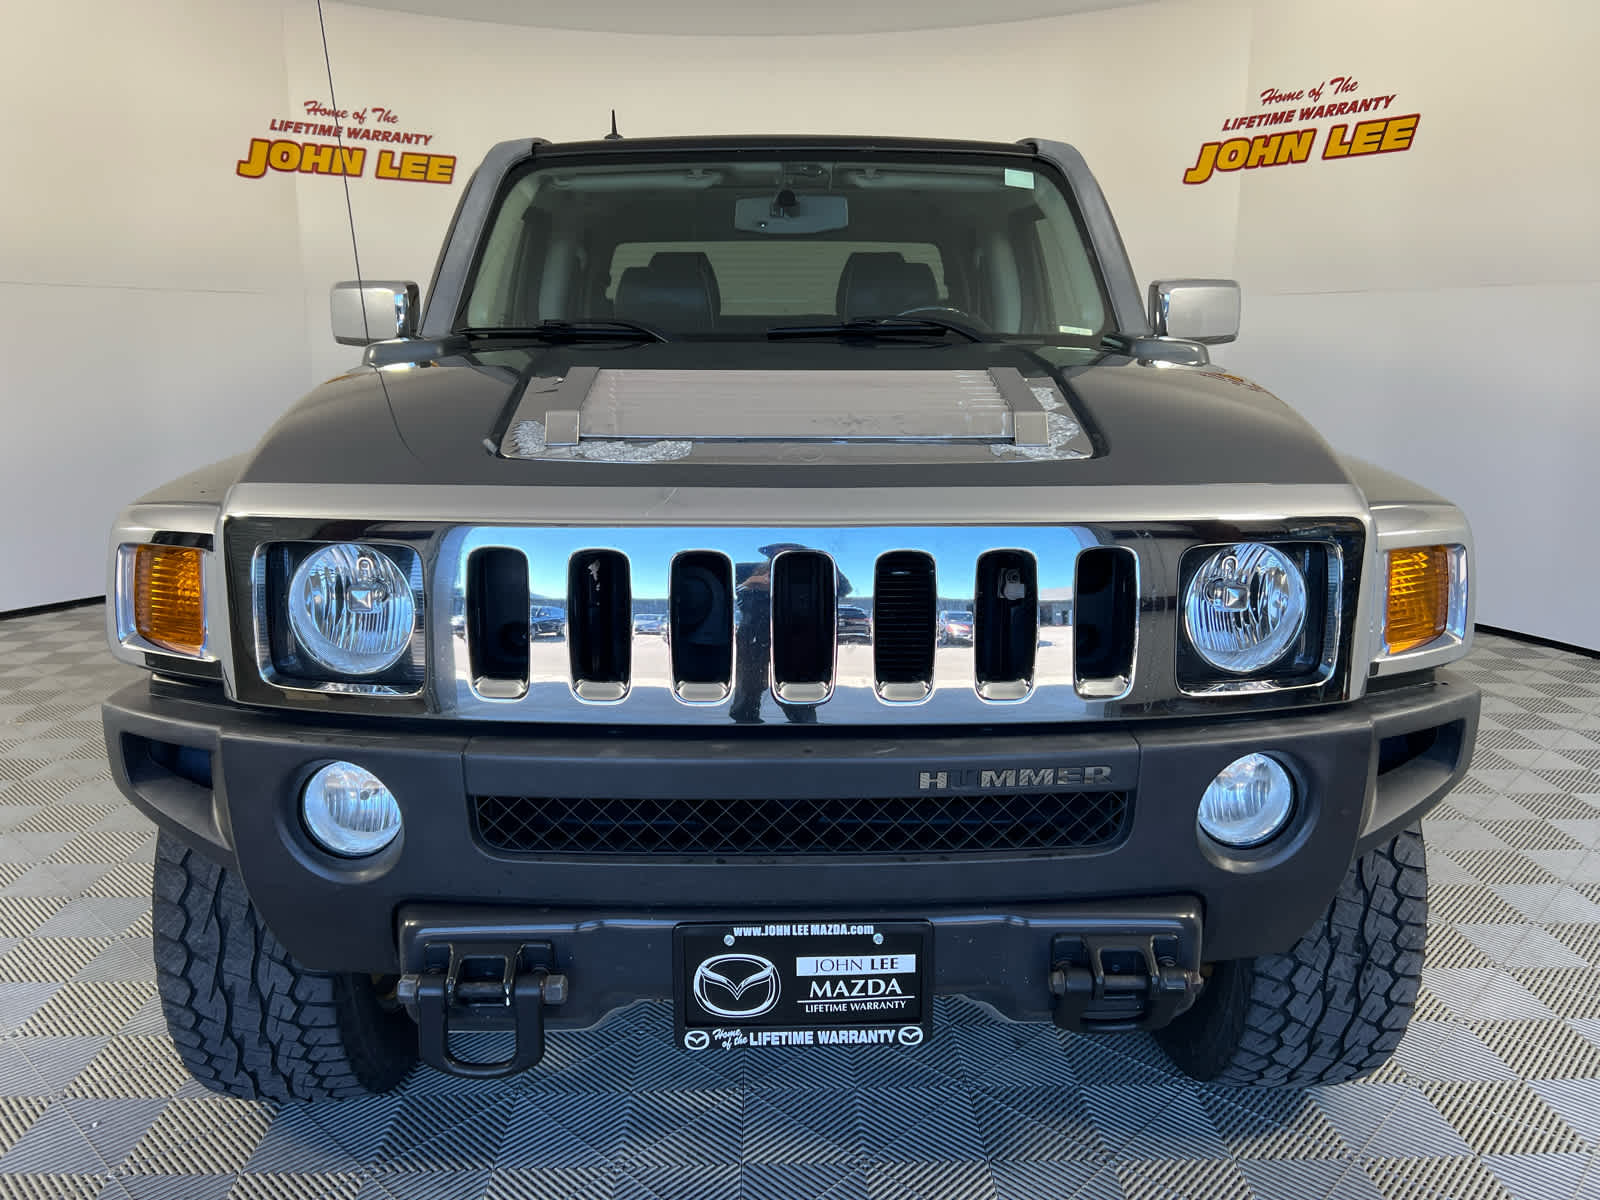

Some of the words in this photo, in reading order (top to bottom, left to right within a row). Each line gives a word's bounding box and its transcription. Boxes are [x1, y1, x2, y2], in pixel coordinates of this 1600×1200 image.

[1260, 88, 1303, 106] Home
[1308, 82, 1325, 102] of
[1329, 76, 1359, 96] The
[304, 100, 348, 119] Home
[352, 108, 367, 124] of
[371, 107, 399, 124] The
[1222, 109, 1296, 132] LIFETIME
[1299, 94, 1396, 121] WARRANTY
[269, 119, 343, 137] LIFETIME
[347, 127, 433, 146] WARRANTY
[1182, 128, 1317, 184] JOHN
[1322, 113, 1420, 160] LEE
[236, 138, 367, 179] JOHN
[375, 149, 457, 184] LEE
[919, 766, 1112, 790] HUMMER
[814, 958, 863, 974] JOHN
[870, 957, 899, 970] LEE
[809, 978, 902, 998] MAZDA
[805, 1002, 848, 1013] LIFETIME
[850, 1000, 907, 1012] WARRANTY
[712, 1028, 741, 1040] Home
[721, 1036, 733, 1050] of
[734, 1033, 748, 1046] the
[749, 1031, 814, 1046] LIFETIME
[817, 1029, 895, 1045] WARRANTY
